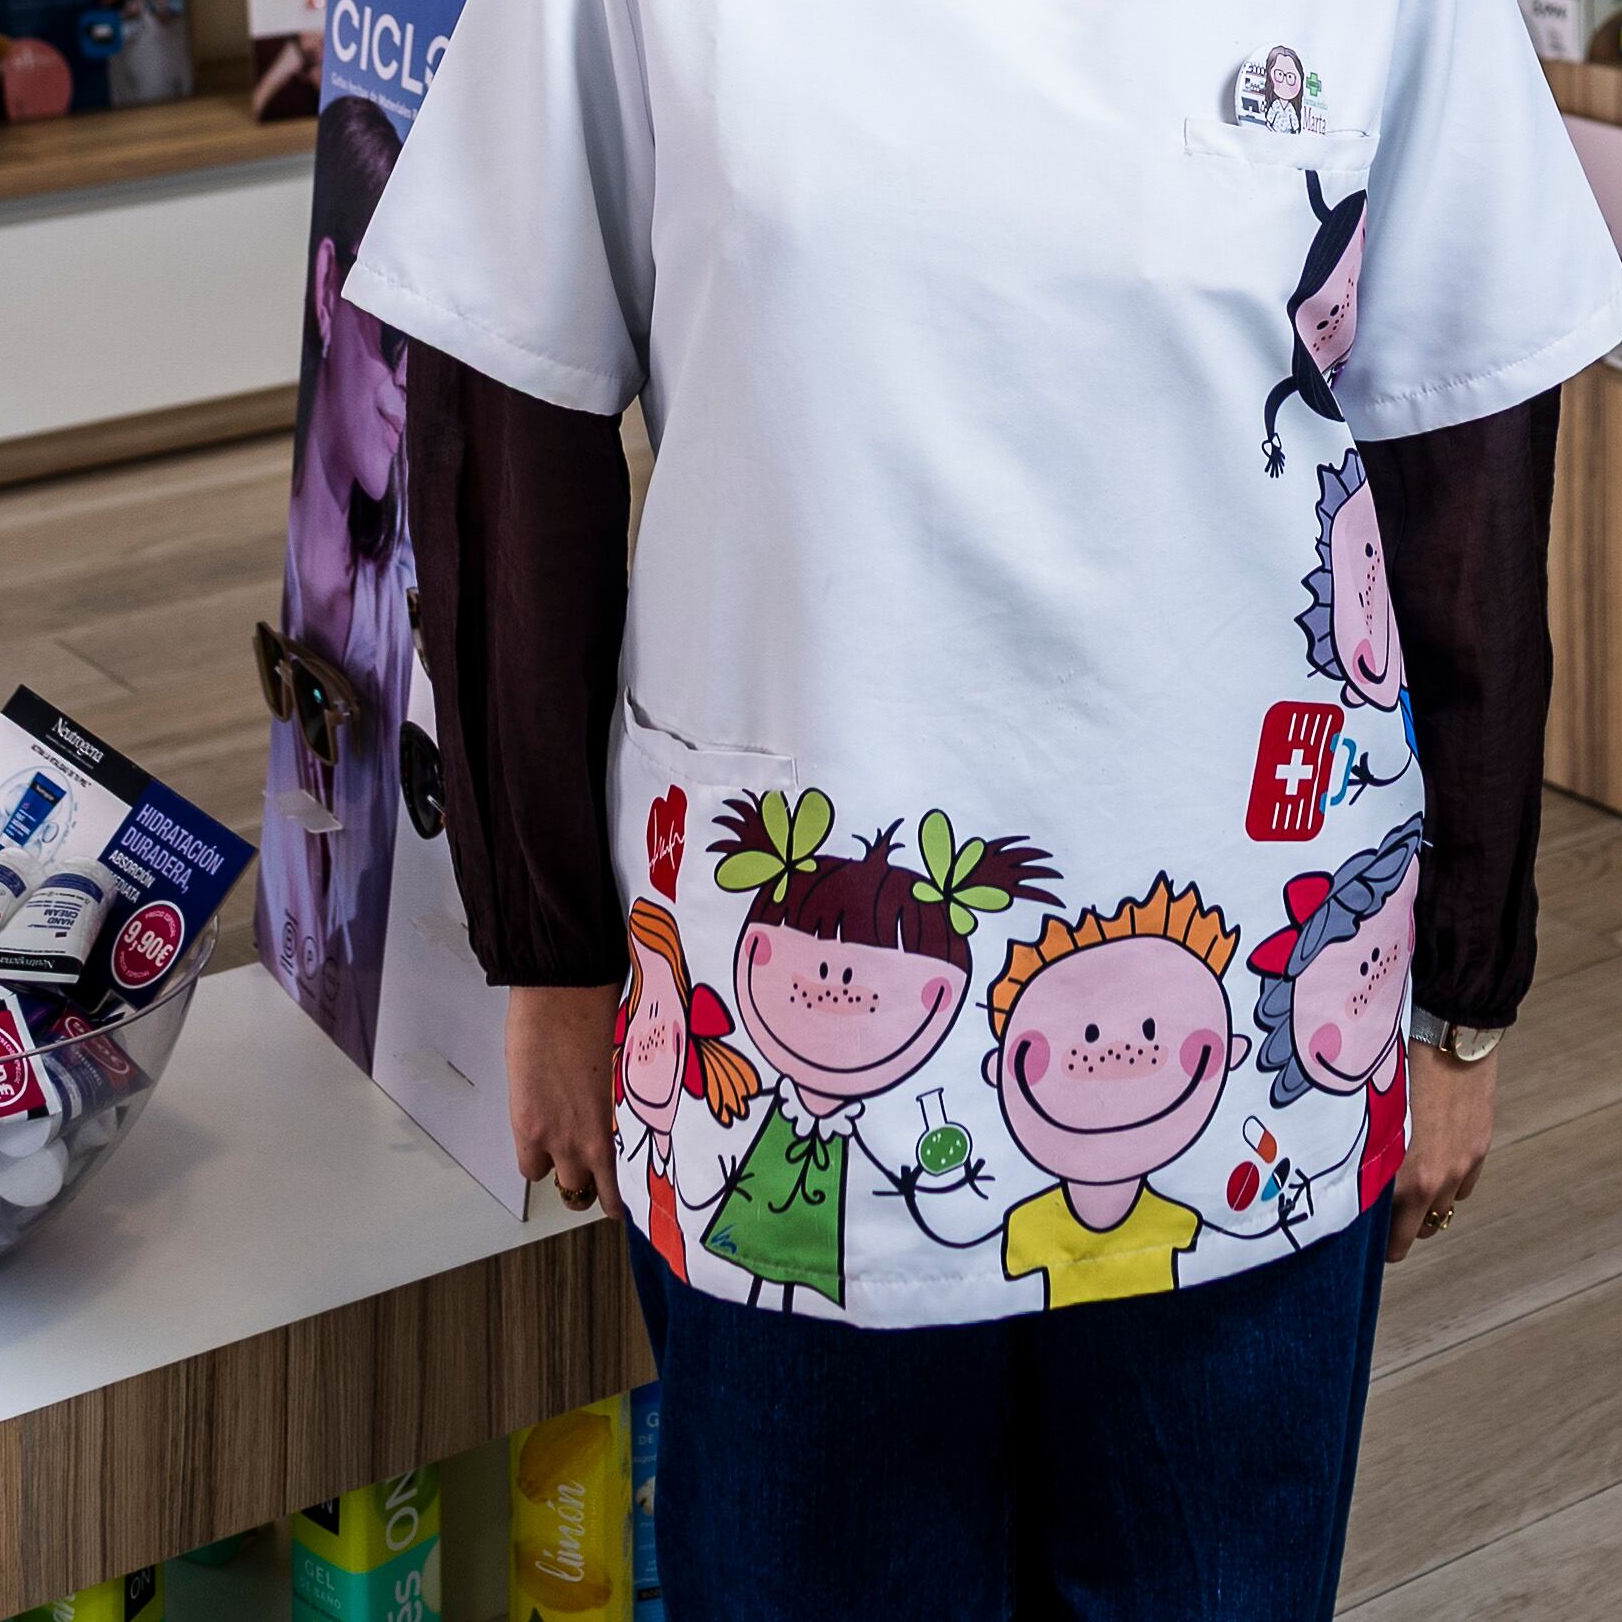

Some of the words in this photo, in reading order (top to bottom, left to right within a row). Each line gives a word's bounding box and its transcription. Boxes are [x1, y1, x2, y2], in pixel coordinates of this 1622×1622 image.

[51, 716, 105, 764] Neutrogena
[120, 825, 191, 895] DURADERA,
[136, 803, 225, 877] HIDRATACIÓN
[108, 849, 156, 889] ABSORCIÓN
[44, 908, 79, 919] CREAM
[46, 917, 76, 927] HAND
[123, 919, 174, 969] 9,90€
[534, 1480, 587, 1584] limón
[303, 1557, 336, 1592] GEL
